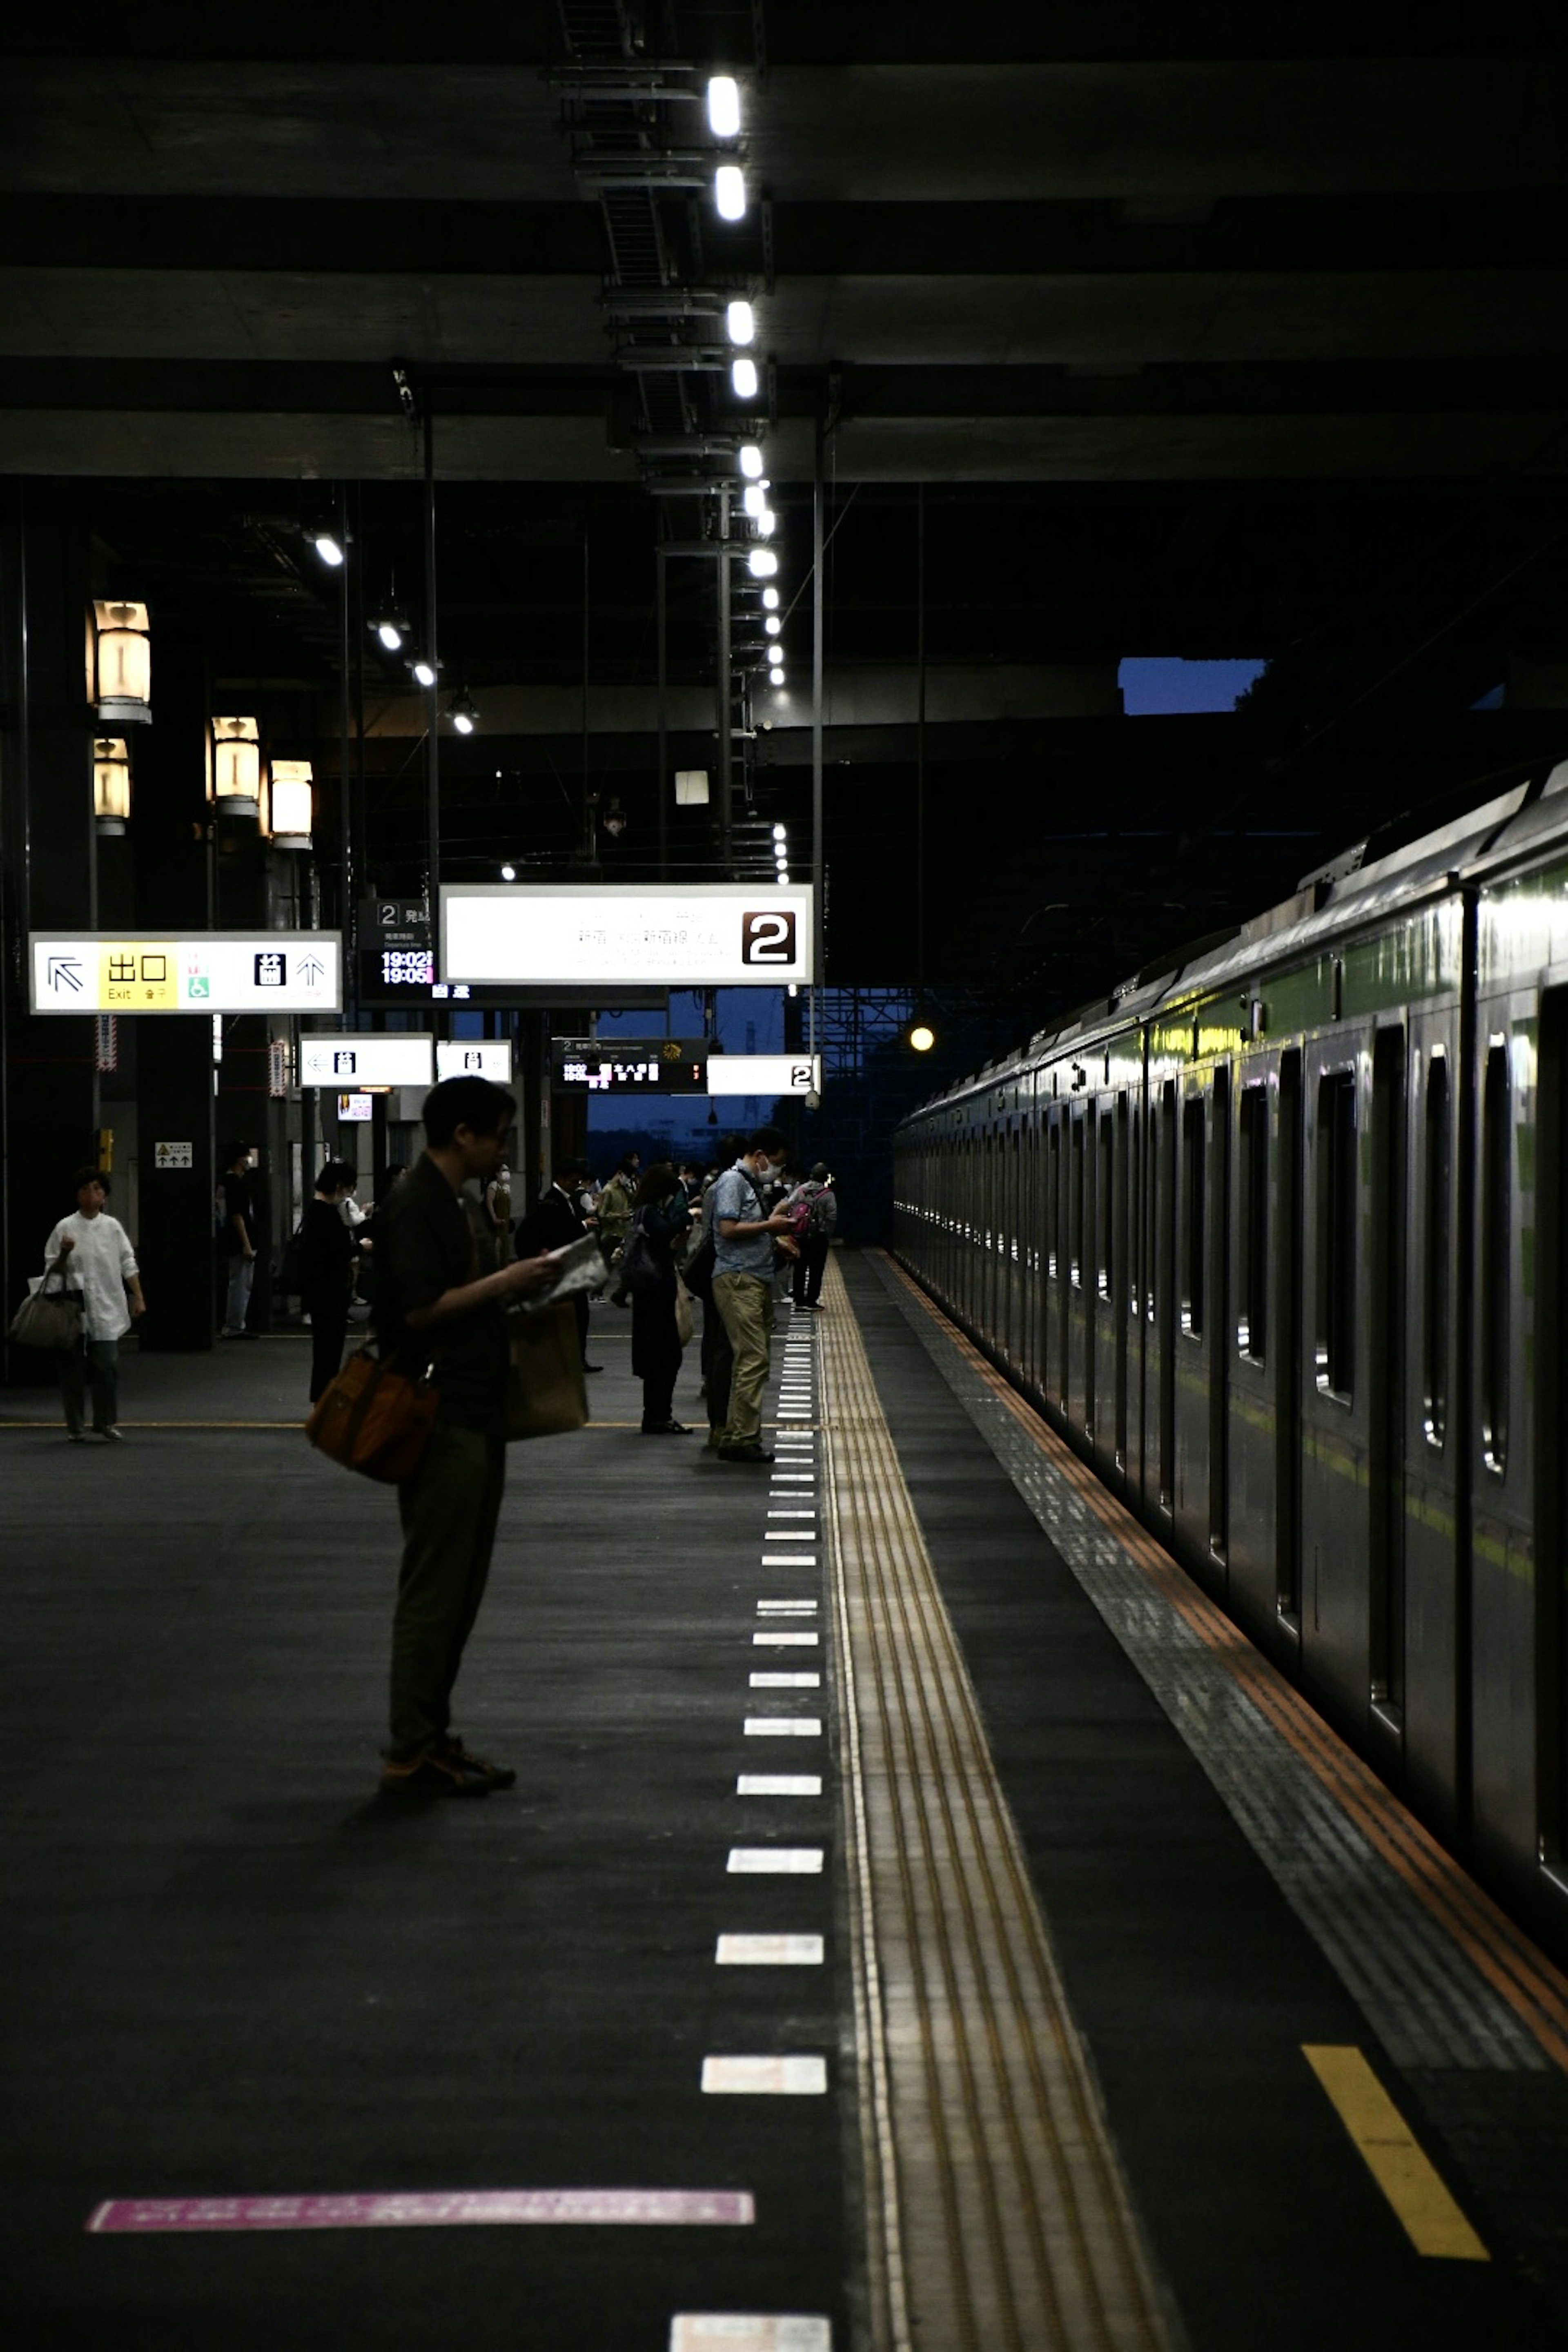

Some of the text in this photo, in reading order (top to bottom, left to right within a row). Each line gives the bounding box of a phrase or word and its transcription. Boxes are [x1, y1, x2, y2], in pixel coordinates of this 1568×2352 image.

[382, 905, 395, 924] 2
[749, 915, 788, 961] 2
[108, 954, 167, 982] 出口
[381, 951, 426, 968] 19:02
[381, 968, 426, 984] 19:05
[108, 988, 131, 999] Exit
[793, 1067, 811, 1086] 2
